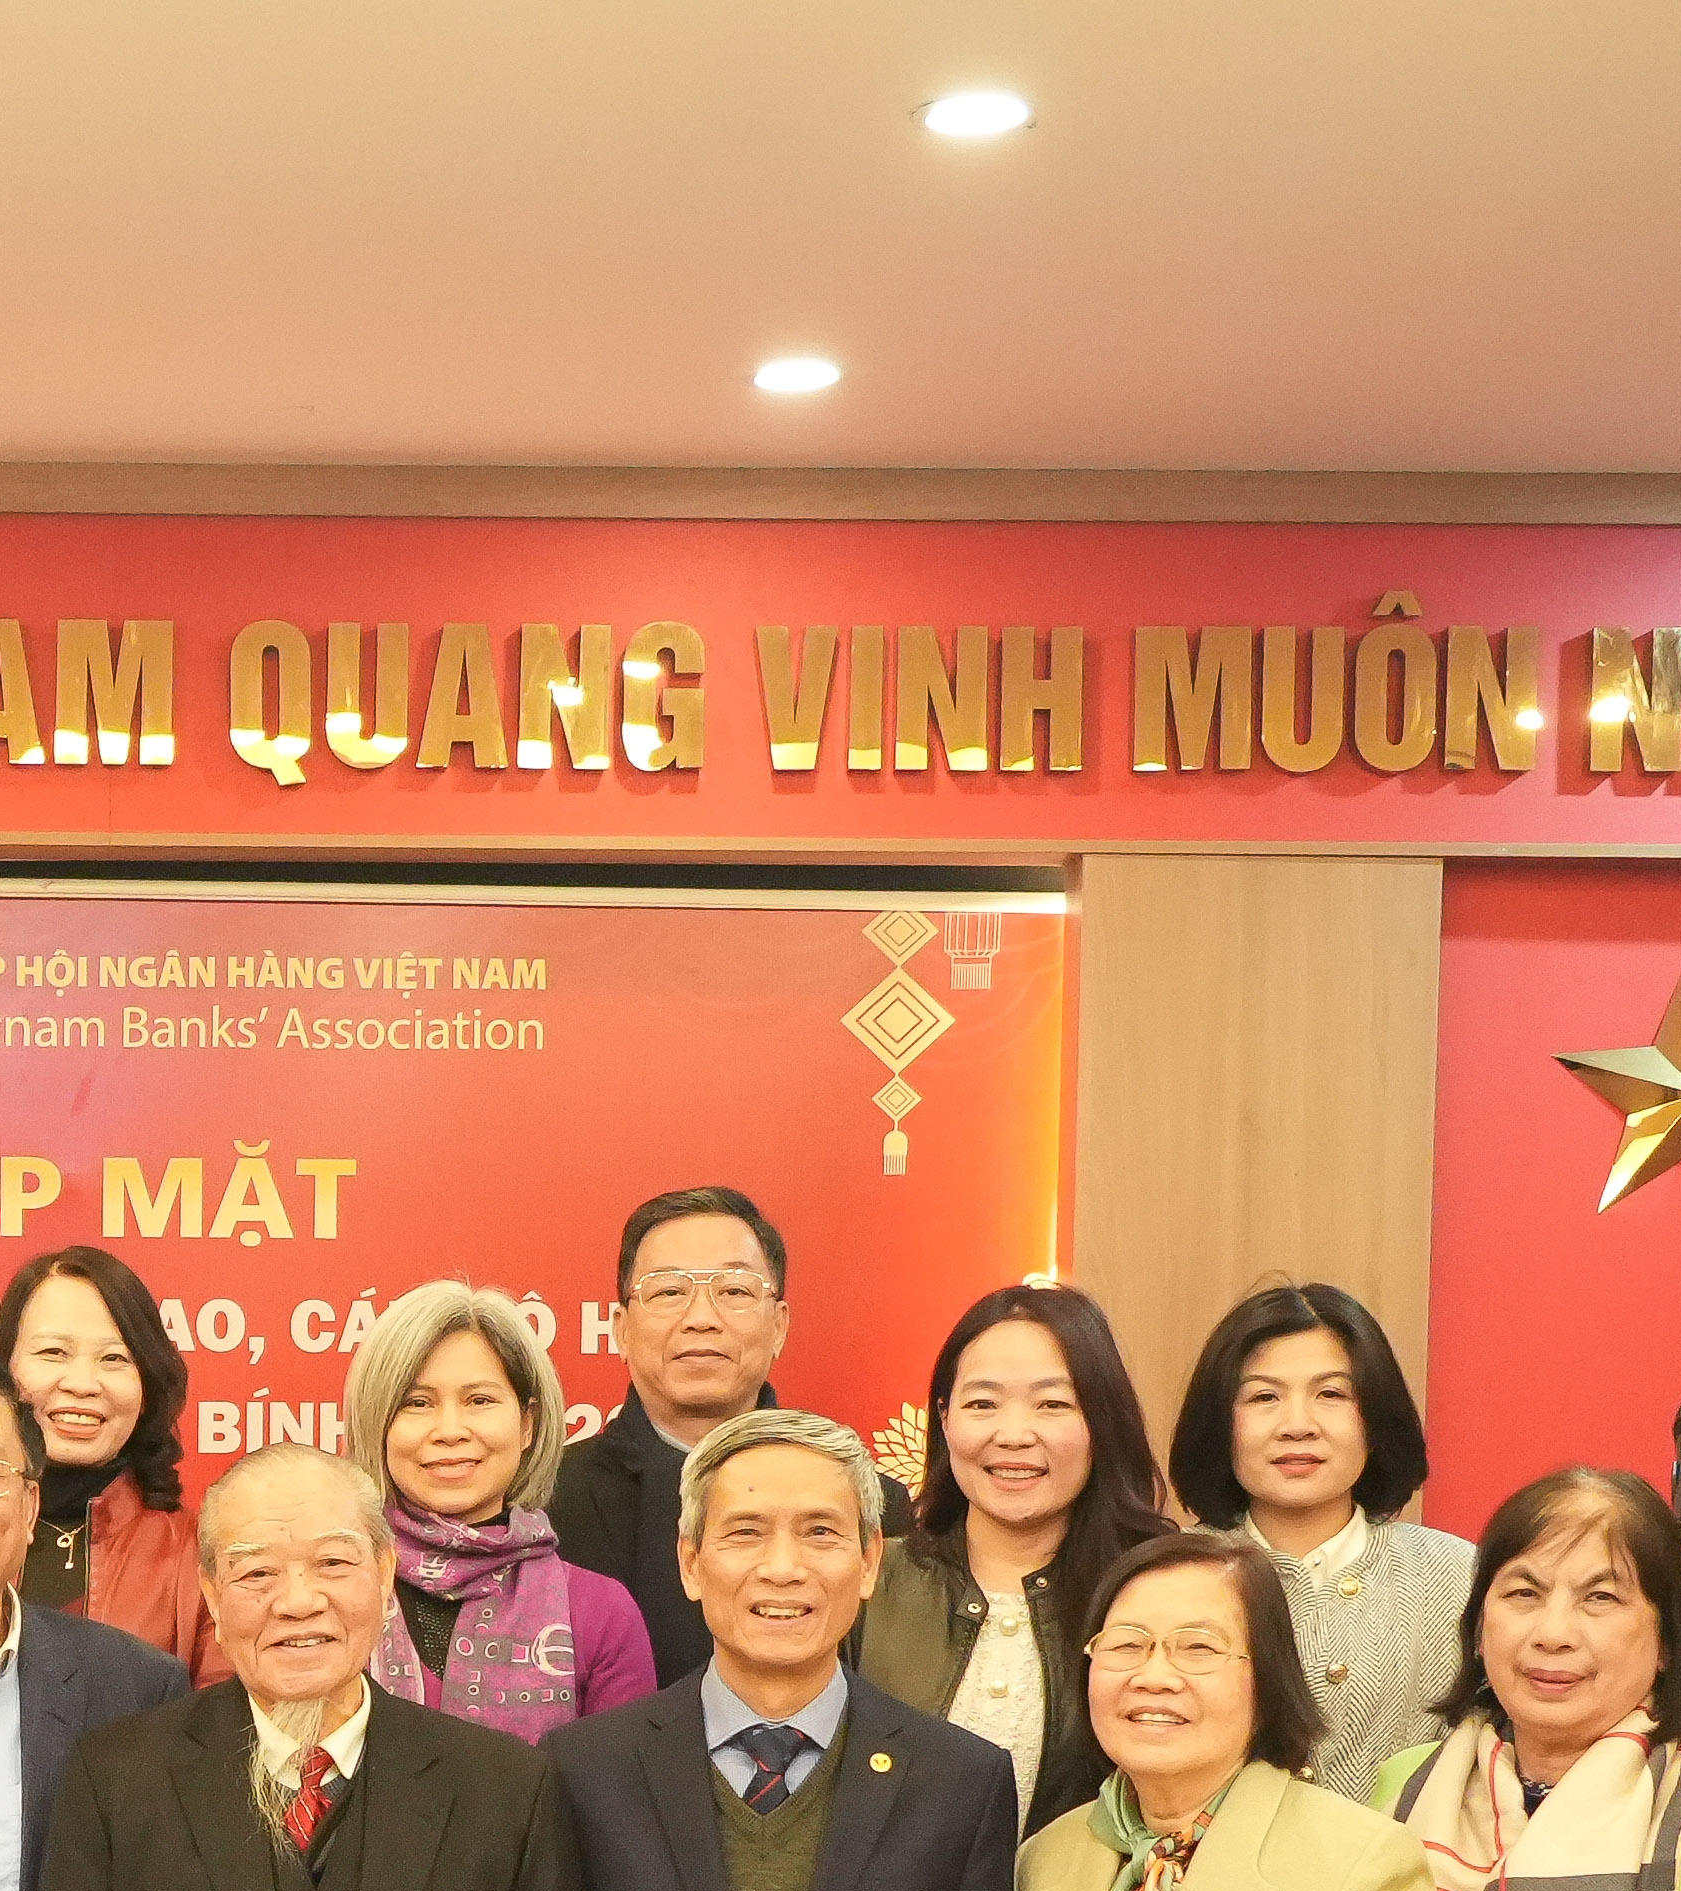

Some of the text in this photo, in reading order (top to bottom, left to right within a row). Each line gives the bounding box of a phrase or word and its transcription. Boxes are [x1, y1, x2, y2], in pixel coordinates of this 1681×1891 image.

[228, 618, 706, 786] QUANG
[755, 625, 1085, 774] VINH
[1132, 588, 1538, 774] MUÔN
[15, 947, 90, 997] HỘI
[97, 949, 218, 990] NGÂN
[228, 949, 347, 991] HÀNG
[352, 952, 443, 1000] VIỆT
[451, 958, 547, 991] NAM
[278, 1007, 544, 1051] Association
[99, 1139, 357, 1247] MẶT
[290, 1286, 404, 1353] CÁ
